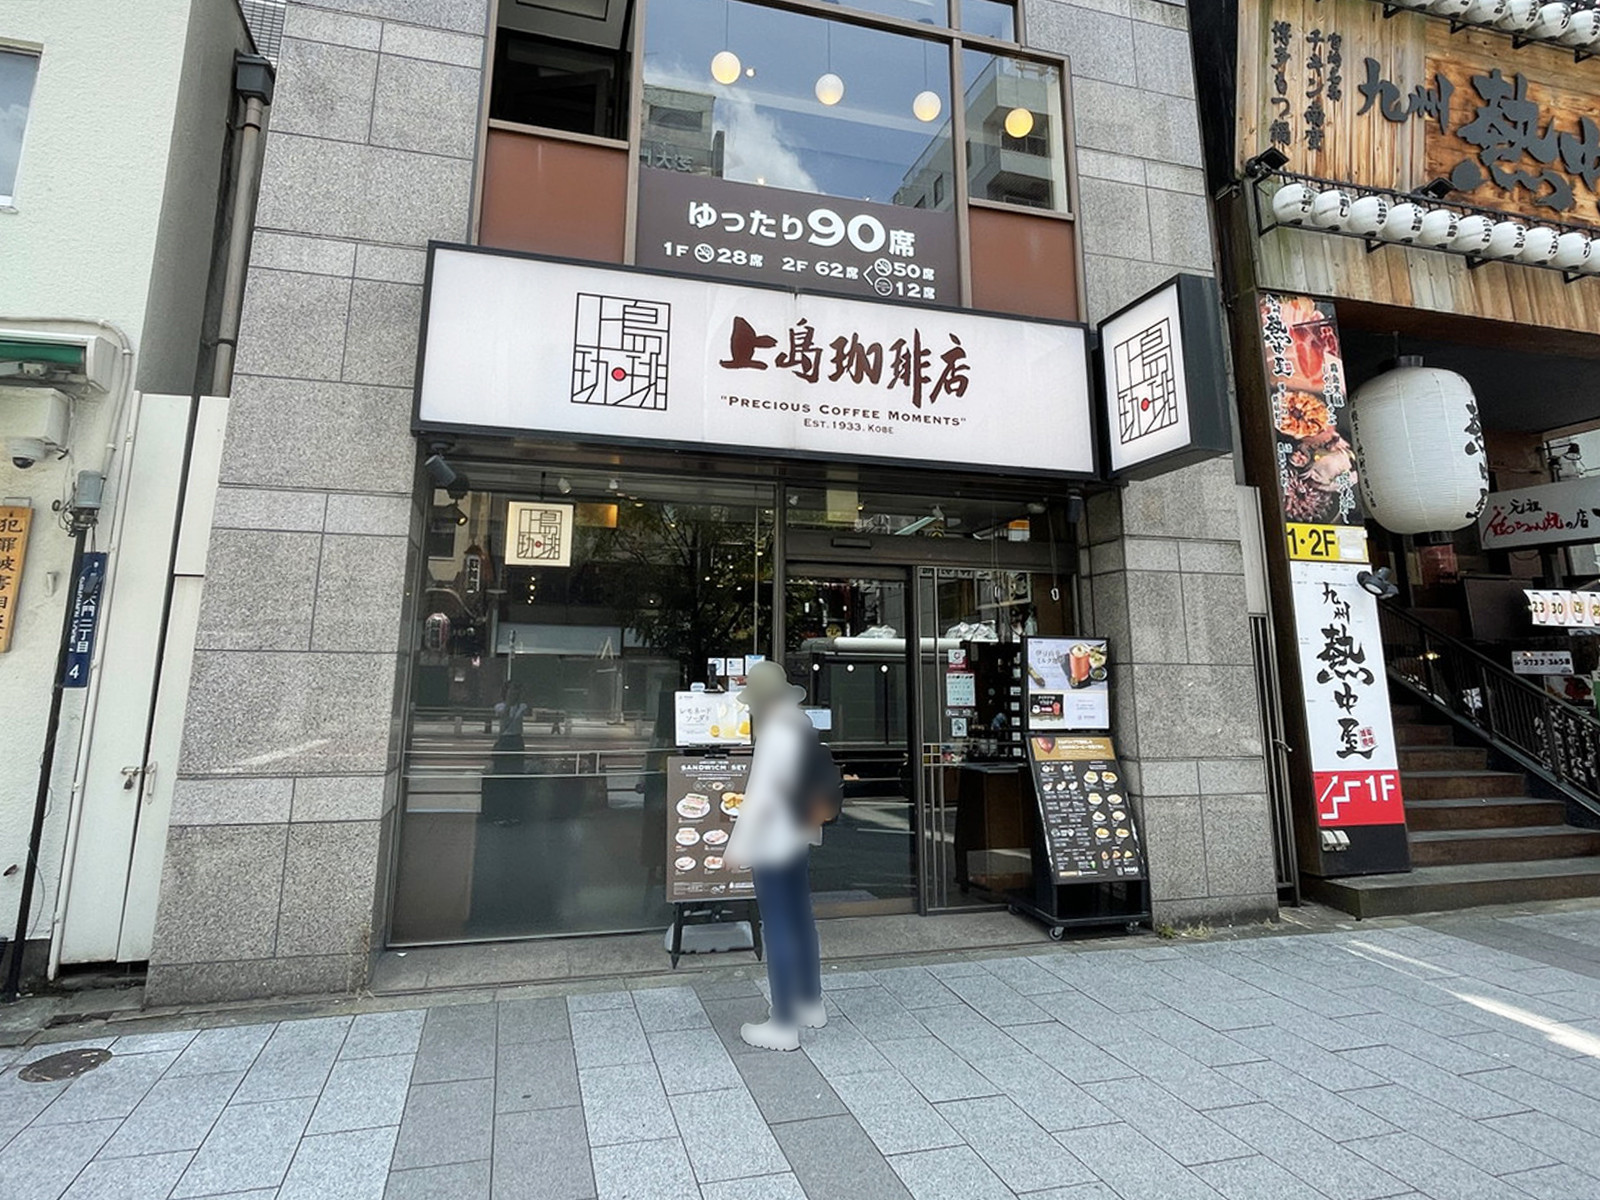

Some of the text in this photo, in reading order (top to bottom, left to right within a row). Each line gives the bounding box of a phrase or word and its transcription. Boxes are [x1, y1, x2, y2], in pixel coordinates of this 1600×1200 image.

[688, 202, 916, 257] ゆったり90席
[663, 242, 689, 257] 1F
[716, 248, 763, 268] 28席
[781, 257, 808, 273] 2F
[719, 315, 971, 409] 上島珈琲店
[819, 405, 880, 419] COFFEE
[68, 664, 80, 680] 4
[1365, 774, 1396, 802] 1F
